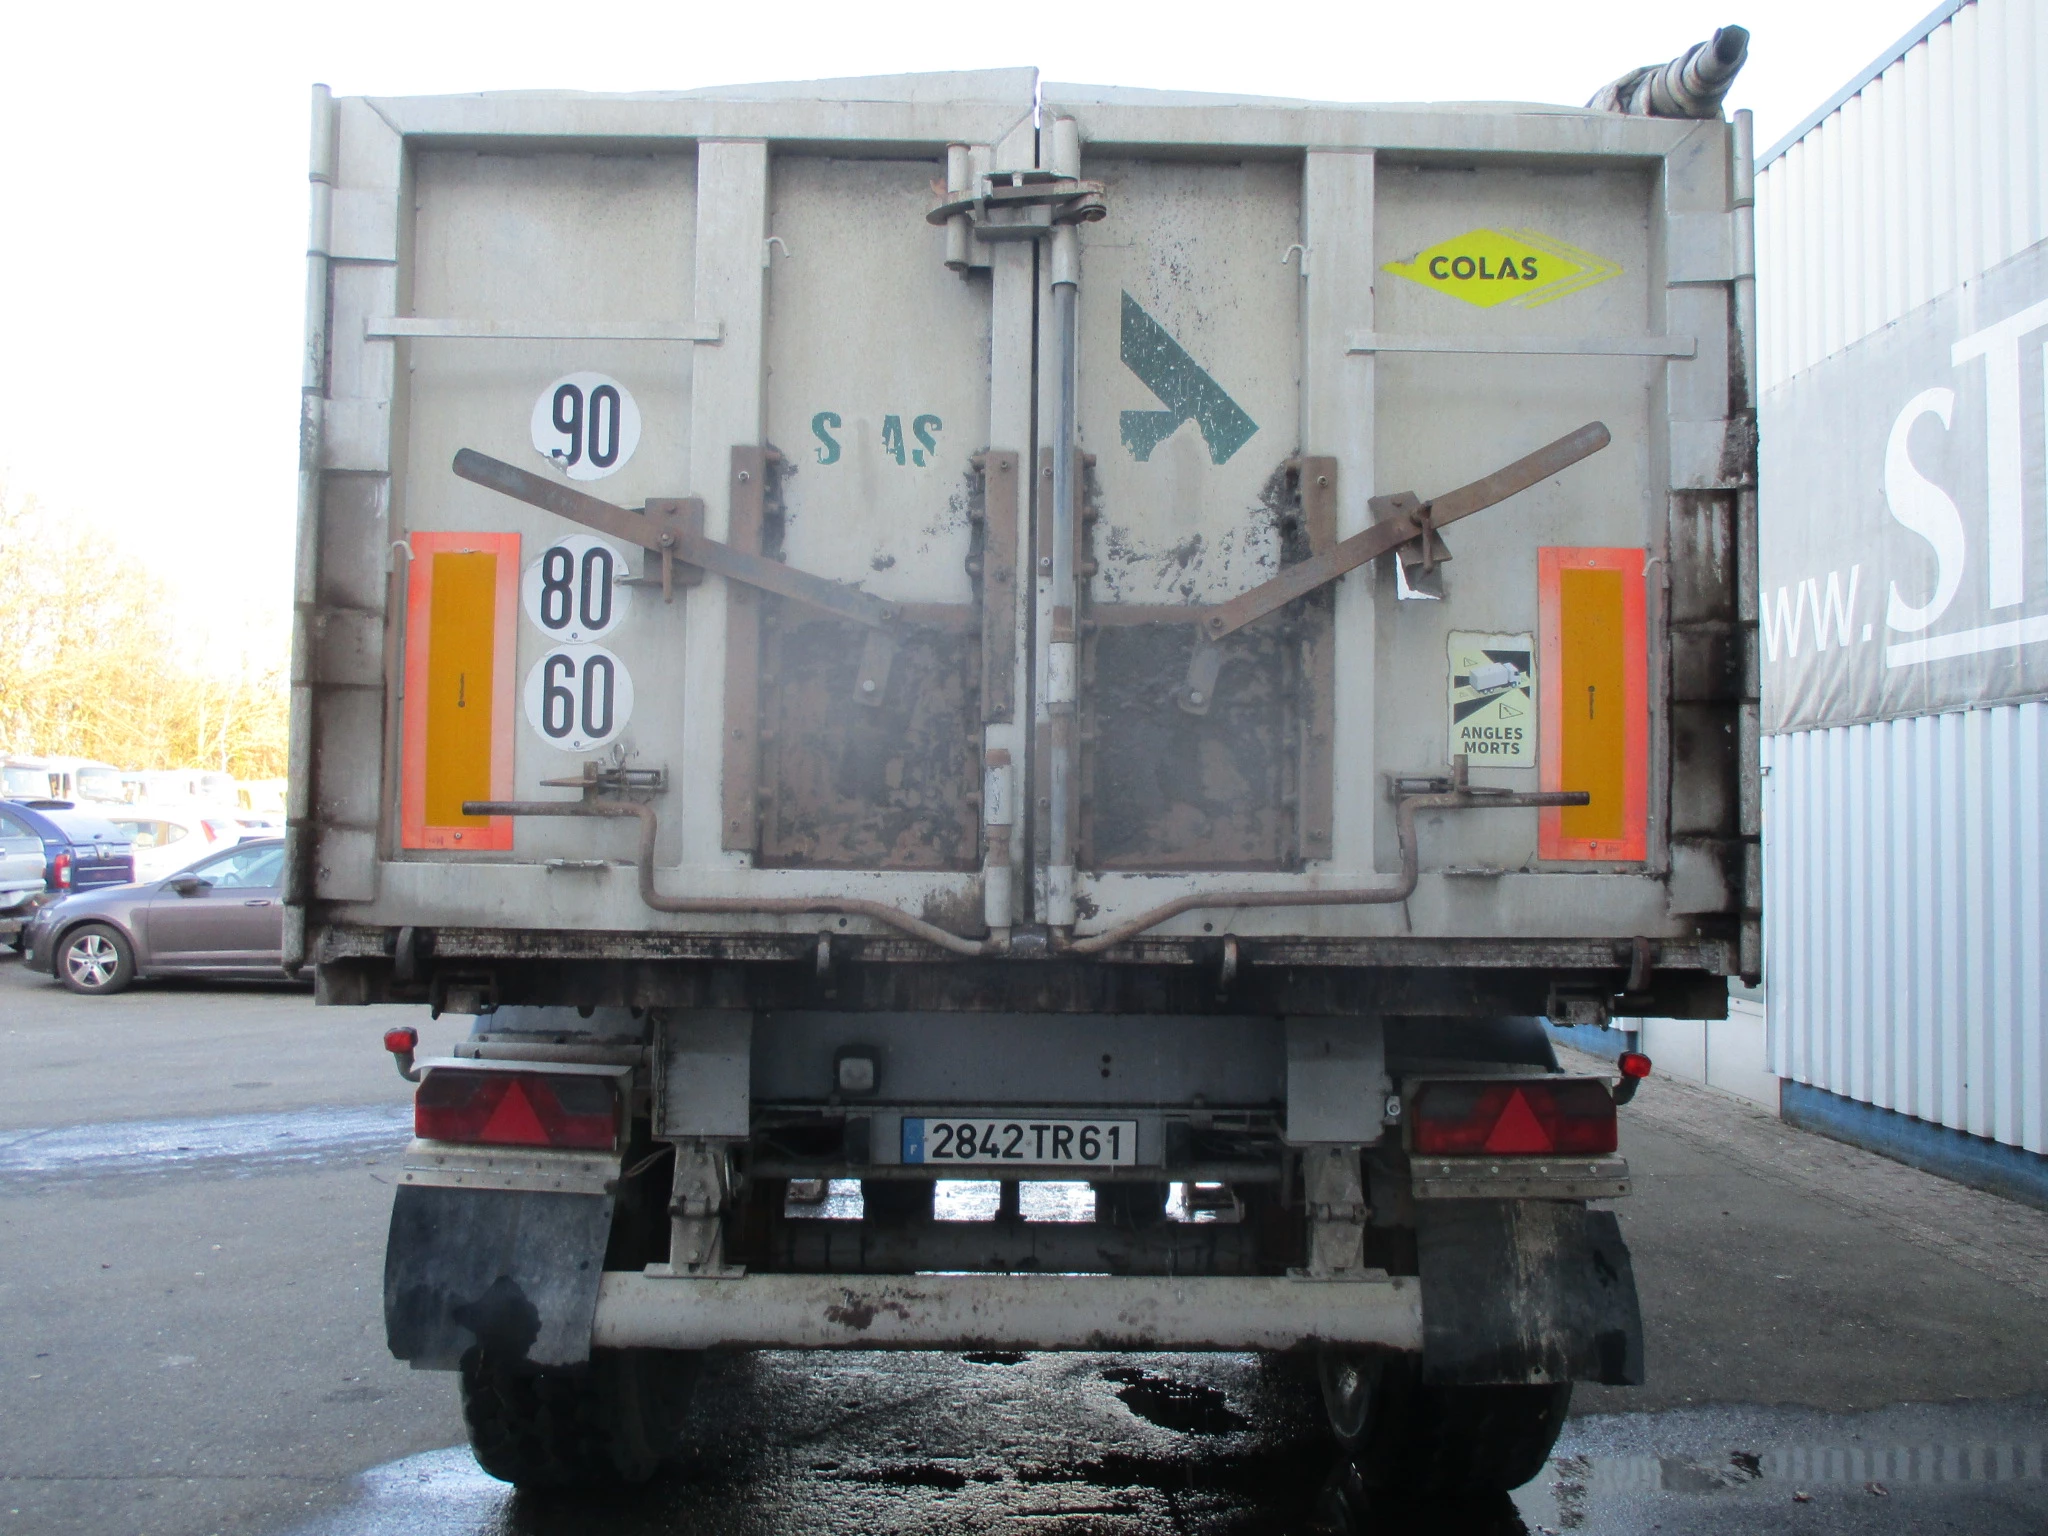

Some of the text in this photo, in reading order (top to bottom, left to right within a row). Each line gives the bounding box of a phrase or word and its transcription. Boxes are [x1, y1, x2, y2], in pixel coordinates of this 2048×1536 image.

[1428, 256, 1538, 280] COLAS
[552, 383, 621, 468] 90
[541, 546, 613, 631] 80
[543, 654, 614, 739] 60
[1461, 726, 1523, 740] ANGLES
[1464, 741, 1520, 755] MORTS
